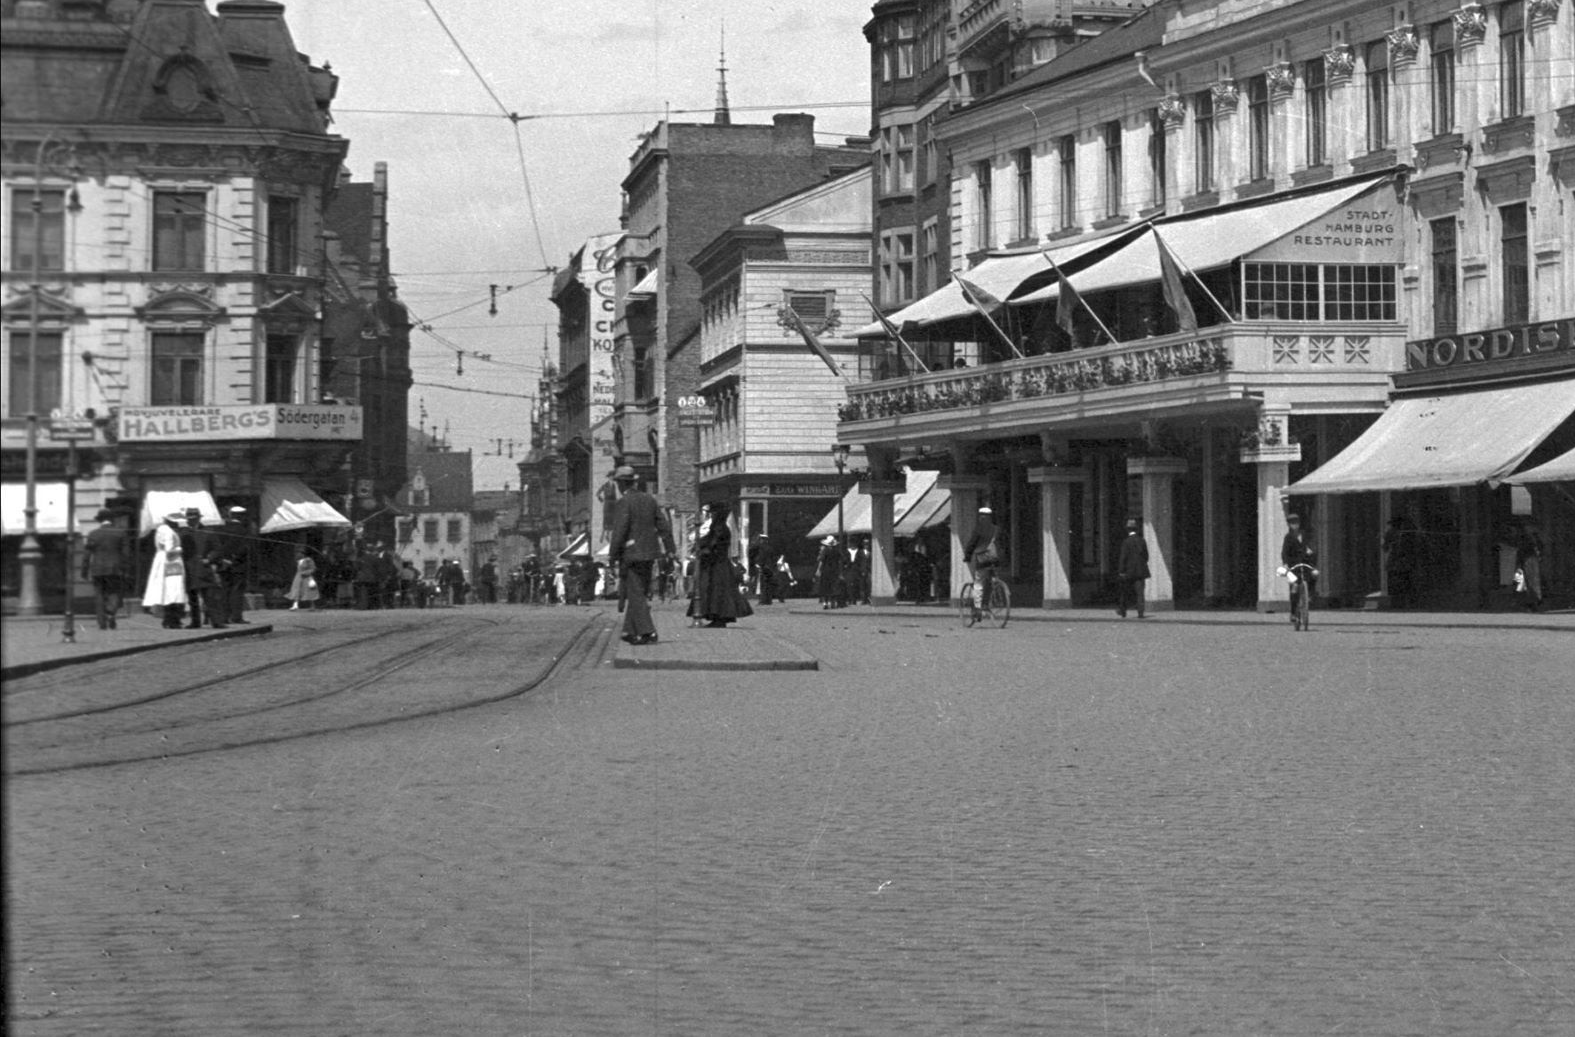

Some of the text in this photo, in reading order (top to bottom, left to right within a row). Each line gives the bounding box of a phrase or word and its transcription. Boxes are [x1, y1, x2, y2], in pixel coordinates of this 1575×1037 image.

[1325, 223, 1394, 234] HAMBURG
[1293, 235, 1394, 247] RESTAURANT
[124, 409, 271, 438] HALLBERG'S
[278, 407, 345, 429] Södergatan
